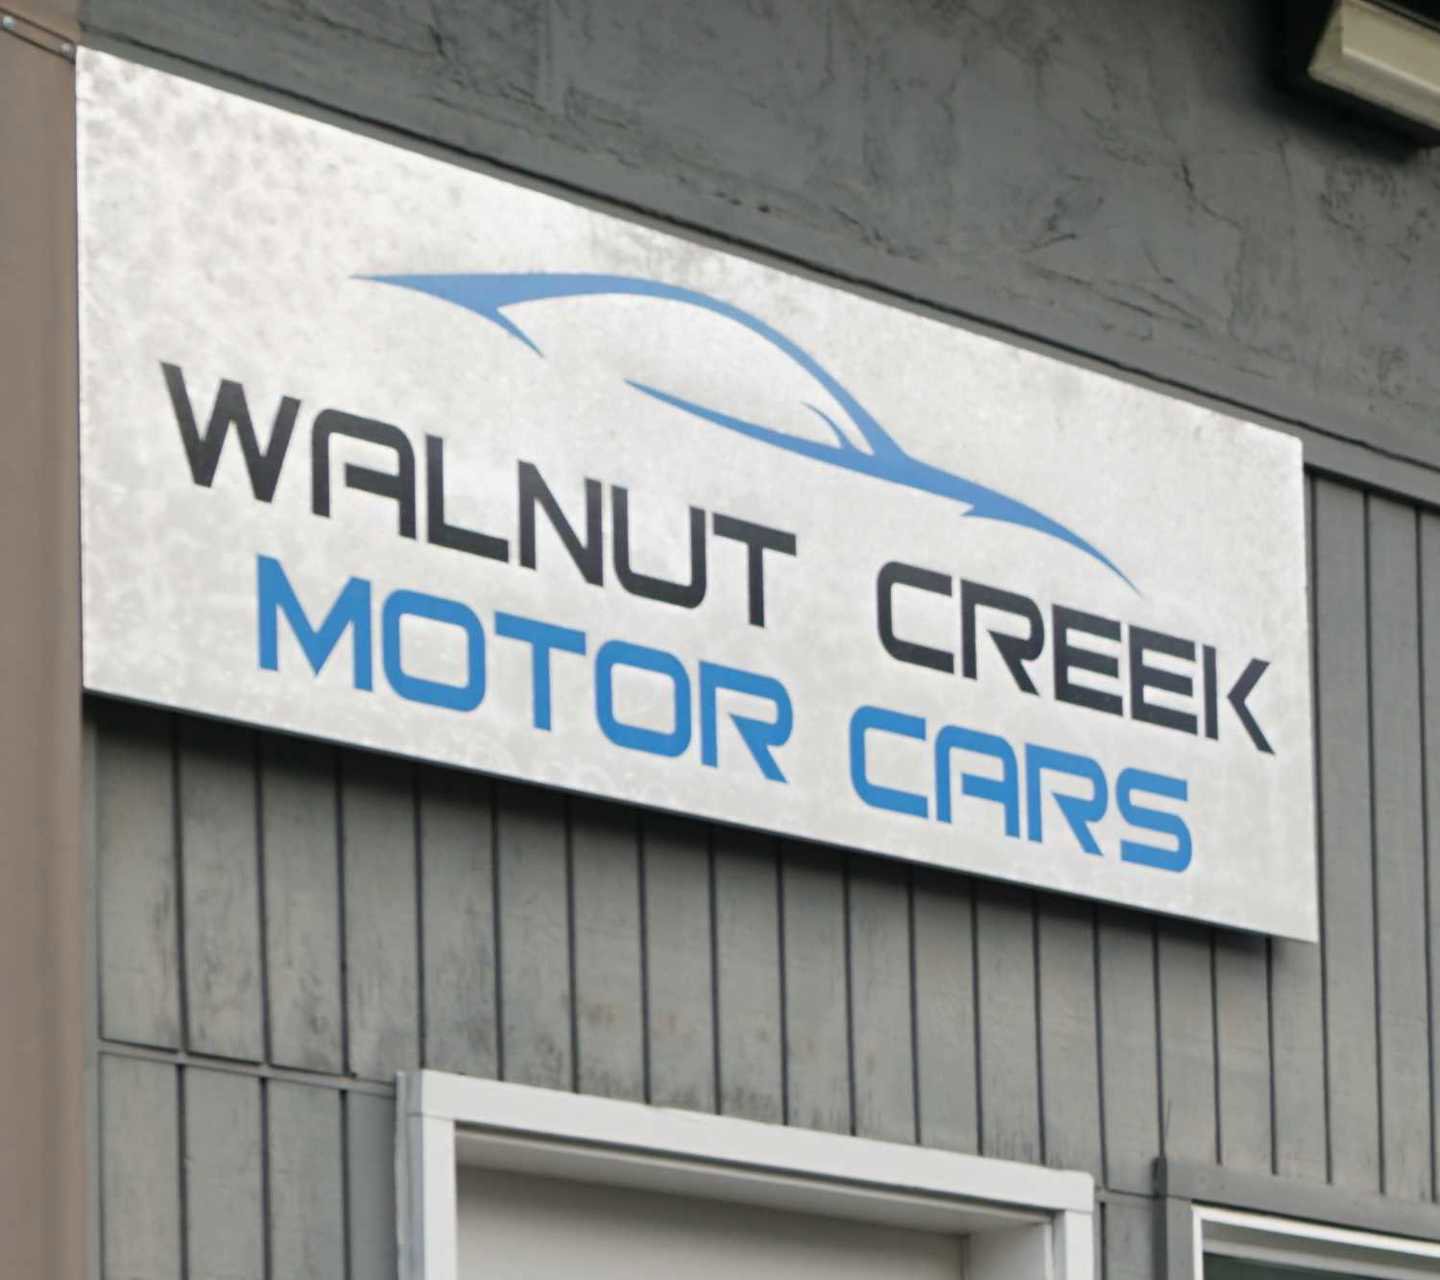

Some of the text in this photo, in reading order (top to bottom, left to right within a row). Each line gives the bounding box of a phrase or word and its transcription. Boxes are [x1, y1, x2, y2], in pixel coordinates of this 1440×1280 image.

[161, 361, 1276, 756] WALNUT CREEK
[255, 554, 1194, 874] MOTOR CARS
